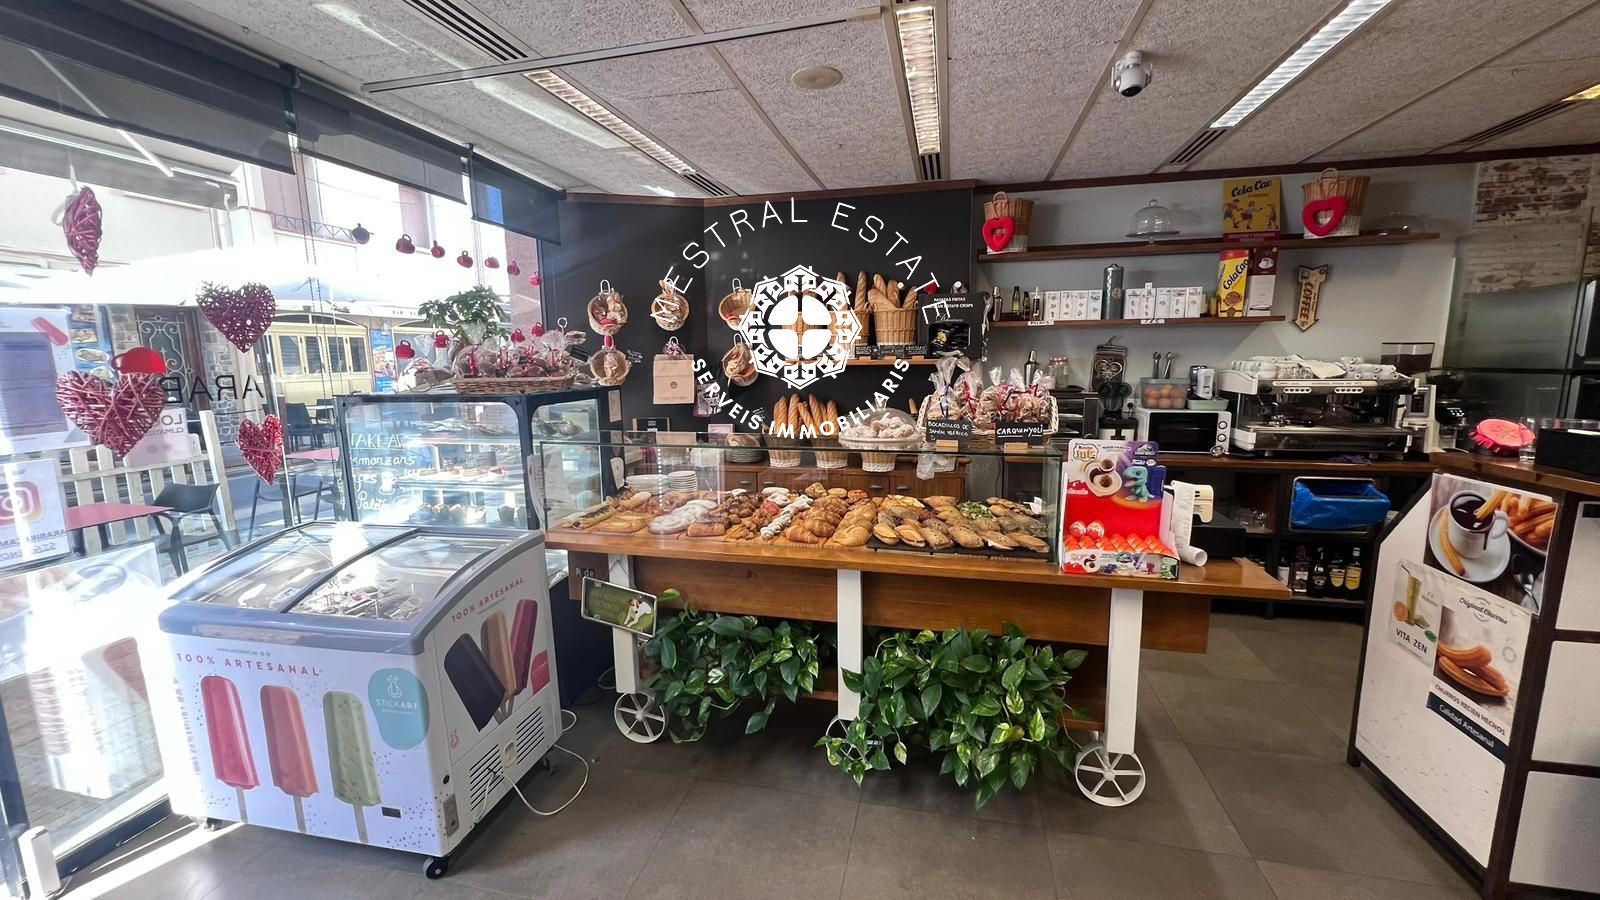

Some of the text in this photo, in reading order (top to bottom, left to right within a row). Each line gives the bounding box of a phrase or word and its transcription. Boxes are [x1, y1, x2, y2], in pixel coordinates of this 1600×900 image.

[1231, 187, 1253, 198] Cola
[1300, 282, 1314, 320] COFFEE
[575, 567, 595, 577] Rde
[451, 606, 475, 623] 100%
[478, 577, 524, 608] ARTESANAL
[1396, 628, 1411, 644] VITA
[1413, 640, 1428, 654] ZEN
[177, 653, 320, 676] 100% ARTESANAL
[1435, 684, 1460, 705] CHURROS
[1481, 714, 1506, 736] HECHOS
[1439, 704, 1494, 748] Calidad Artesanal
